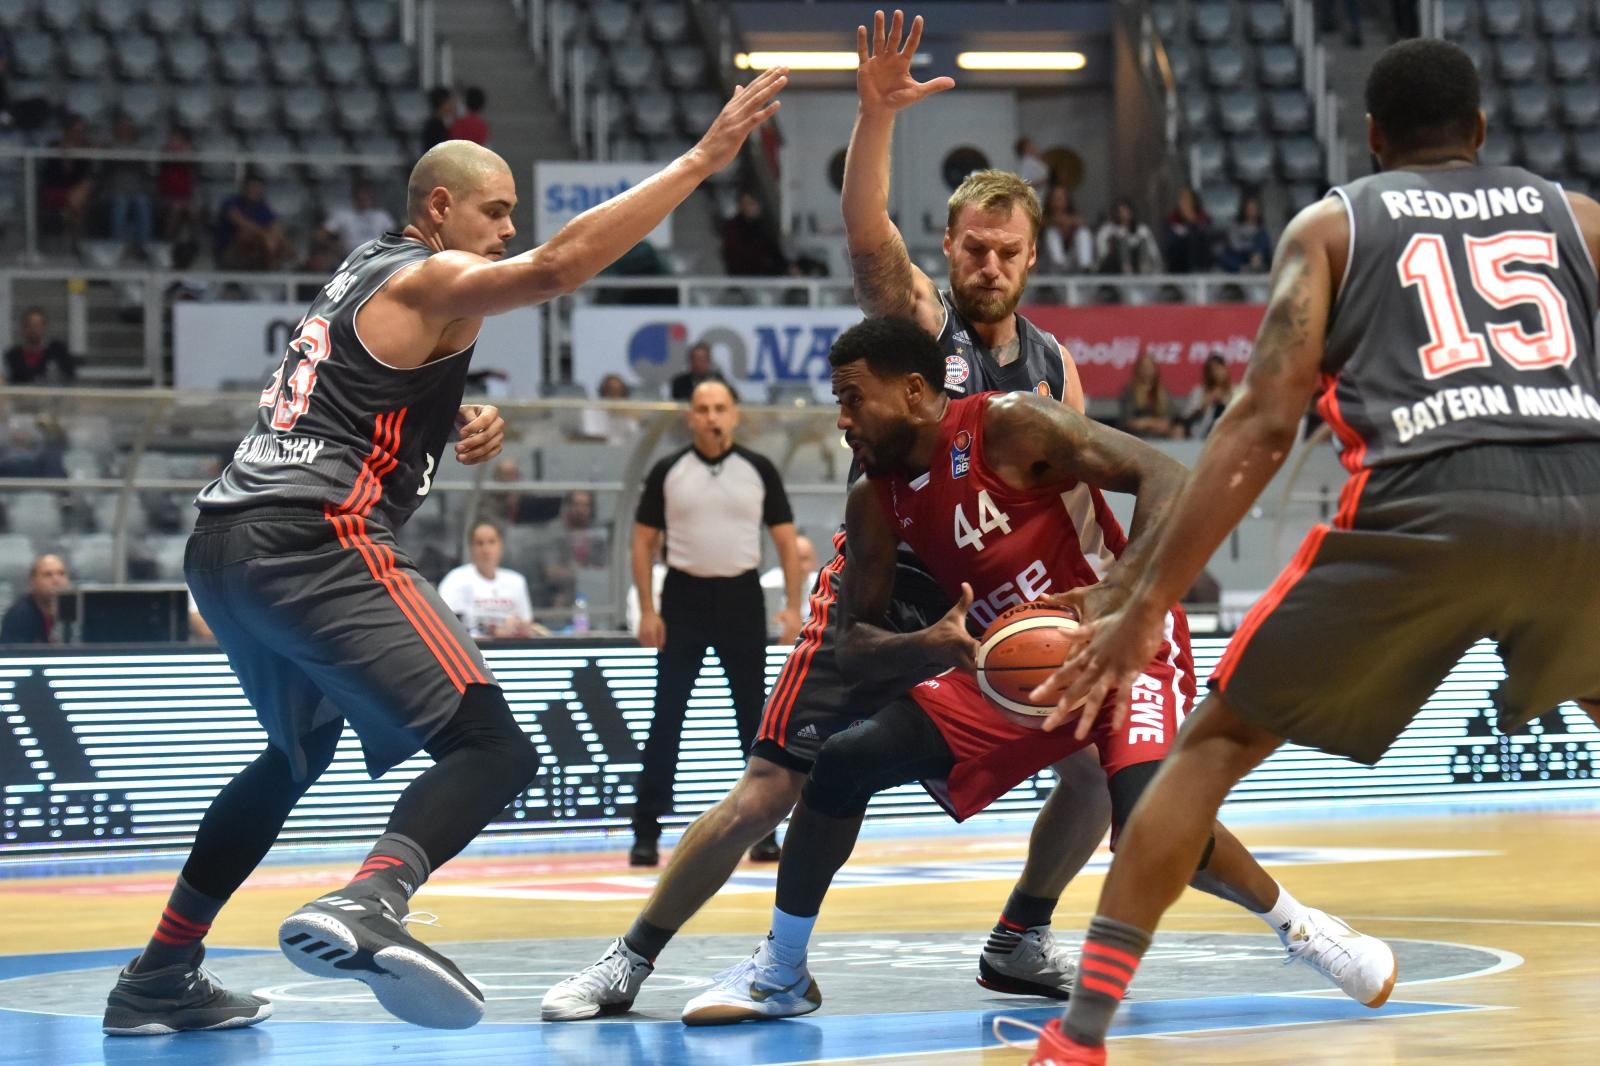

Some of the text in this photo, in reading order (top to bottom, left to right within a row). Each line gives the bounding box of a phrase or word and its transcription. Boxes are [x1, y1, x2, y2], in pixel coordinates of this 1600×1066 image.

[1381, 186, 1543, 220] REDDING
[1397, 230, 1576, 380] 15
[1392, 385, 1511, 443] BAYERN
[954, 489, 1012, 552] 44
[968, 559, 1052, 630] ose
[1128, 672, 1165, 745] REWE
